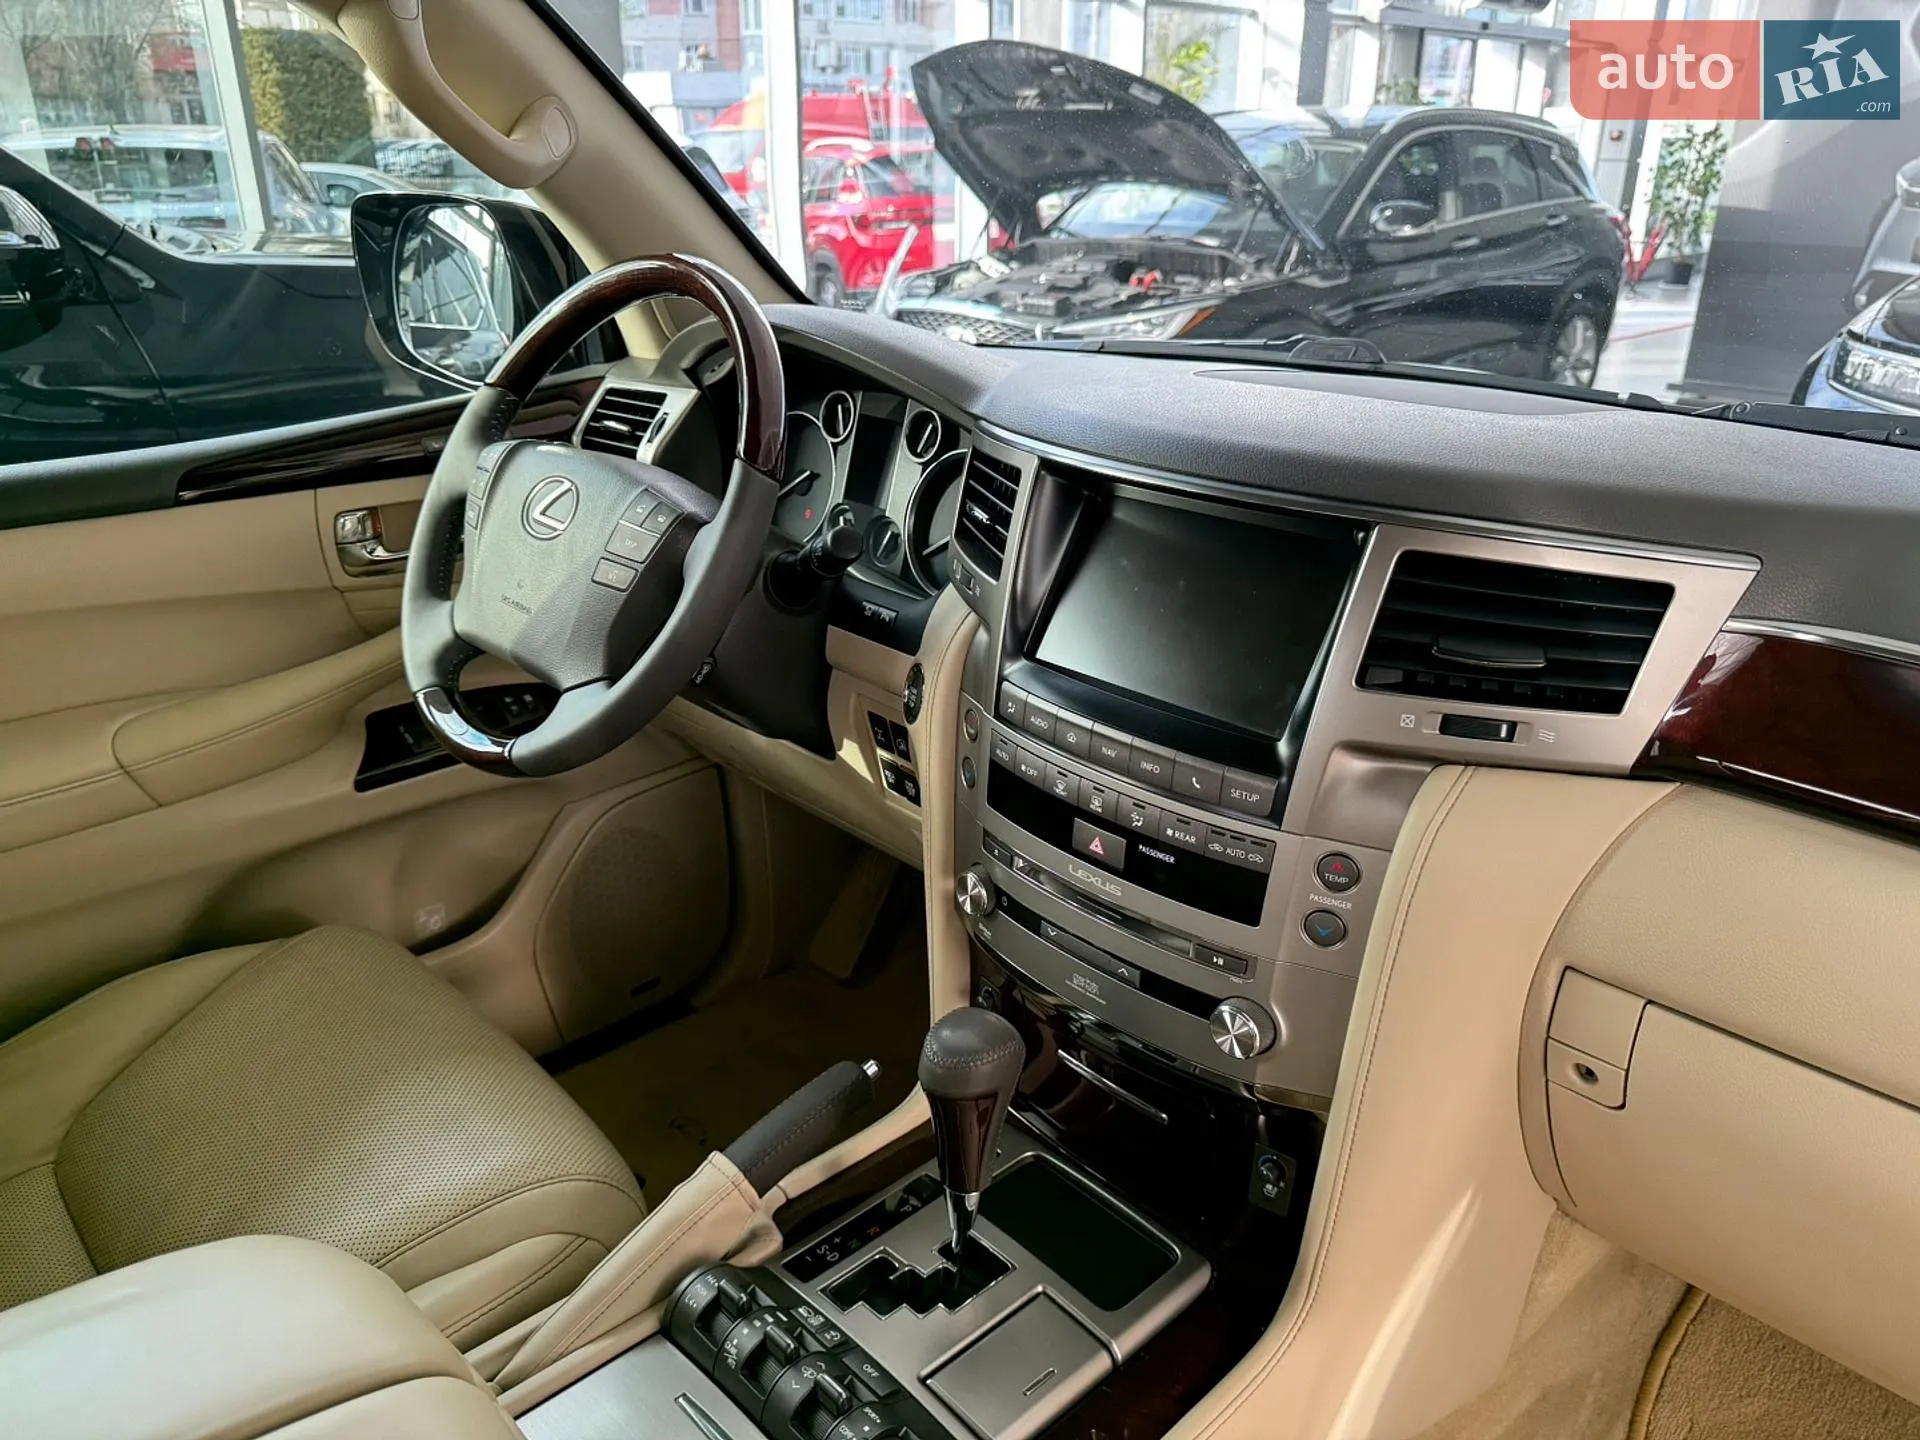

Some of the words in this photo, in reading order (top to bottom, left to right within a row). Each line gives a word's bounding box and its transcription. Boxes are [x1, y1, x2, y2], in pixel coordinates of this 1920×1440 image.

[1101, 746, 1118, 759] NAV
[1026, 765, 1038, 777] OFF
[1140, 760, 1161, 774] INFO
[1230, 788, 1260, 803] SETUP
[1174, 830, 1197, 844] REAR
[1138, 843, 1175, 864] PASSENGER
[1225, 847, 1246, 860] AUTO
[1067, 863, 1122, 897] LEXUS
[1324, 872, 1349, 884] TEMP
[1308, 893, 1352, 910] PASSENGER
[862, 1363, 880, 1377] OFF
